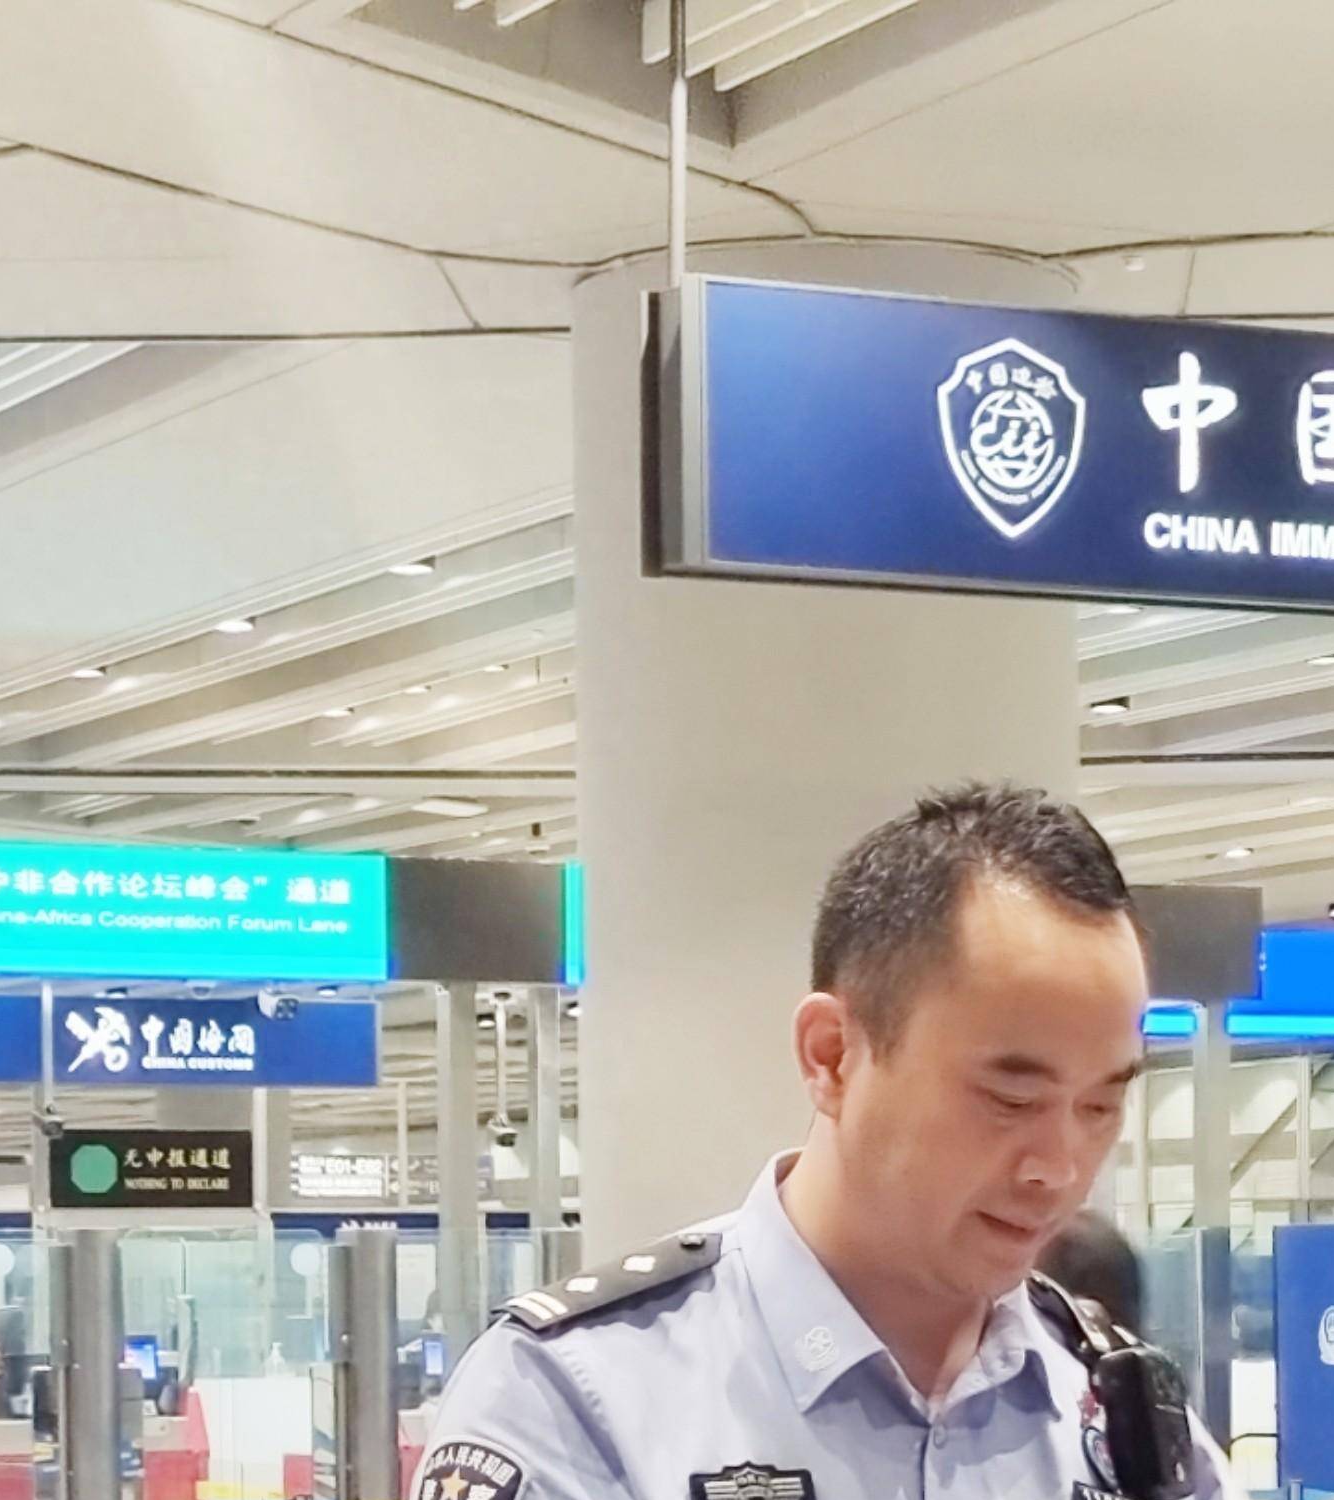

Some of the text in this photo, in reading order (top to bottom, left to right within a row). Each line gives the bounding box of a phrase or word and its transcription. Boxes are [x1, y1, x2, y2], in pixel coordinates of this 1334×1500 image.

[1144, 512, 1259, 554] CHINA
[97, 911, 222, 932] Cooperation
[227, 914, 293, 933] Forum
[298, 917, 349, 934] Lane
